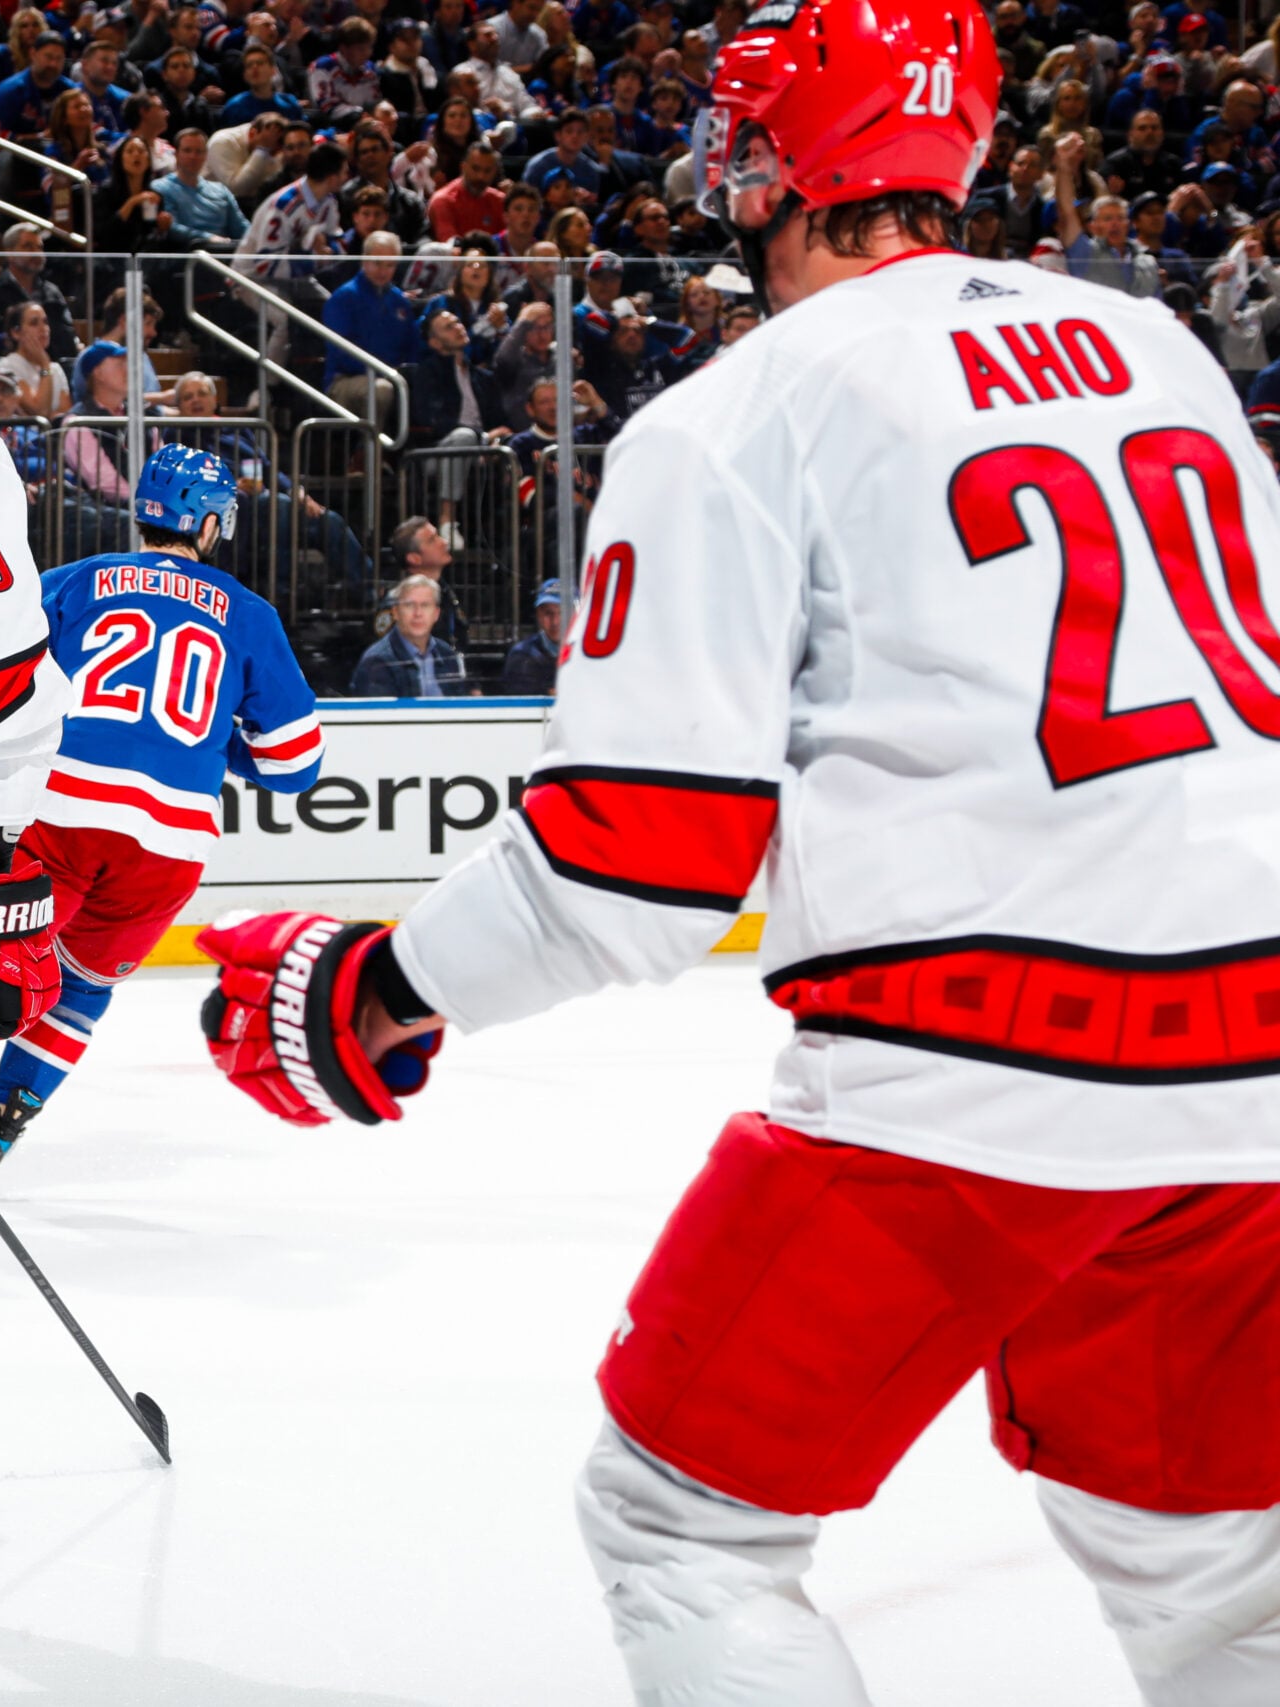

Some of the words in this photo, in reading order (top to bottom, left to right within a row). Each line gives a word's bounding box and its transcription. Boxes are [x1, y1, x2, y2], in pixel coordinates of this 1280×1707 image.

[902, 60, 954, 117] 20
[950, 318, 1132, 411] AHO
[144, 499, 164, 518] 20
[94, 565, 230, 626] KREIDER
[557, 540, 635, 667] 0
[947, 426, 1280, 791] 20
[67, 608, 227, 747] 20
